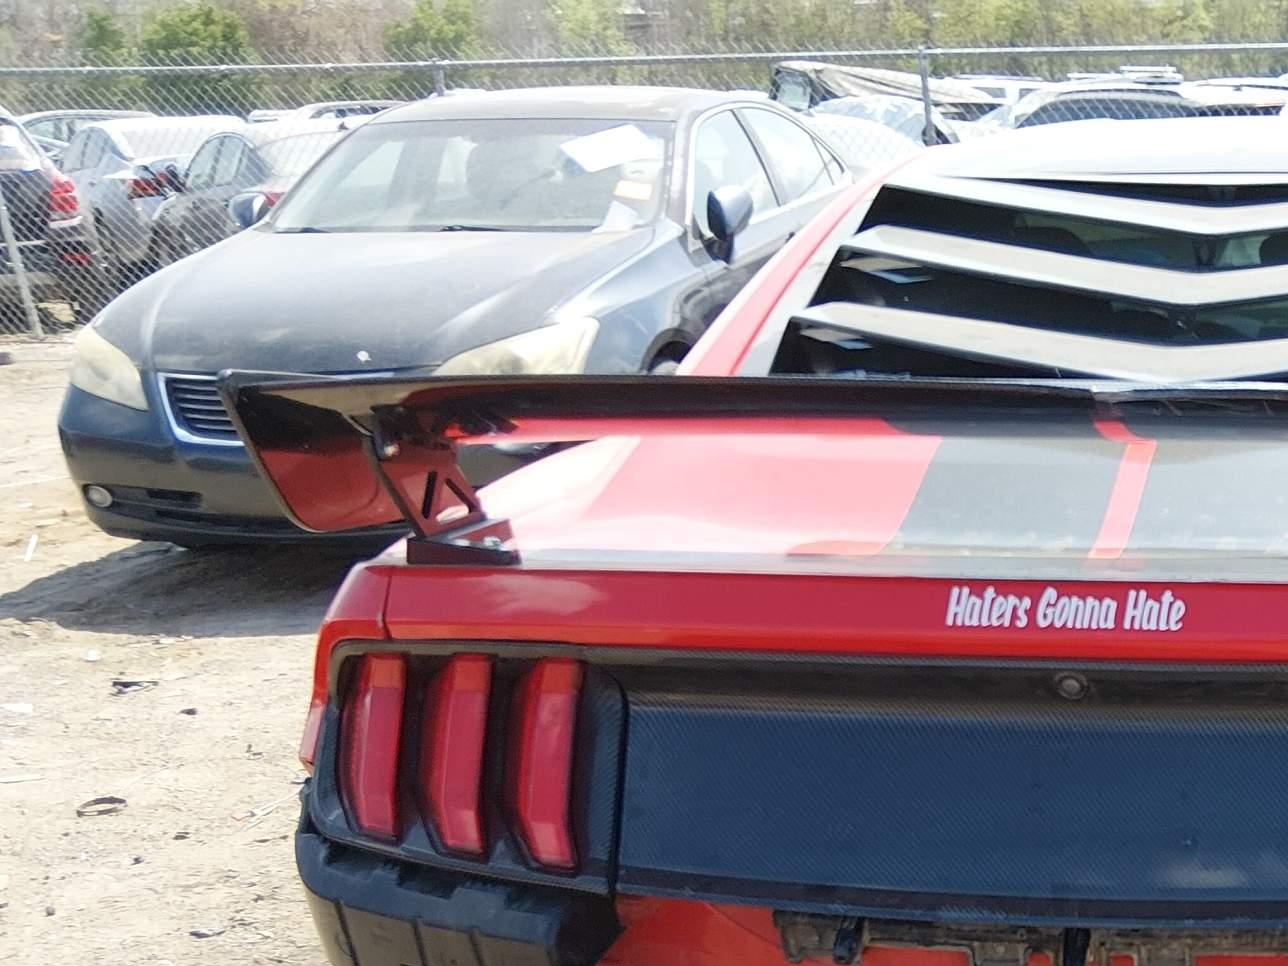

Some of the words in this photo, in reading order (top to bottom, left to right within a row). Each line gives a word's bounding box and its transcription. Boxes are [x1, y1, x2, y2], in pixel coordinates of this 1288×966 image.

[945, 585, 1032, 628] Haters
[1035, 586, 1118, 629] Gonna
[1123, 589, 1186, 631] Hate
